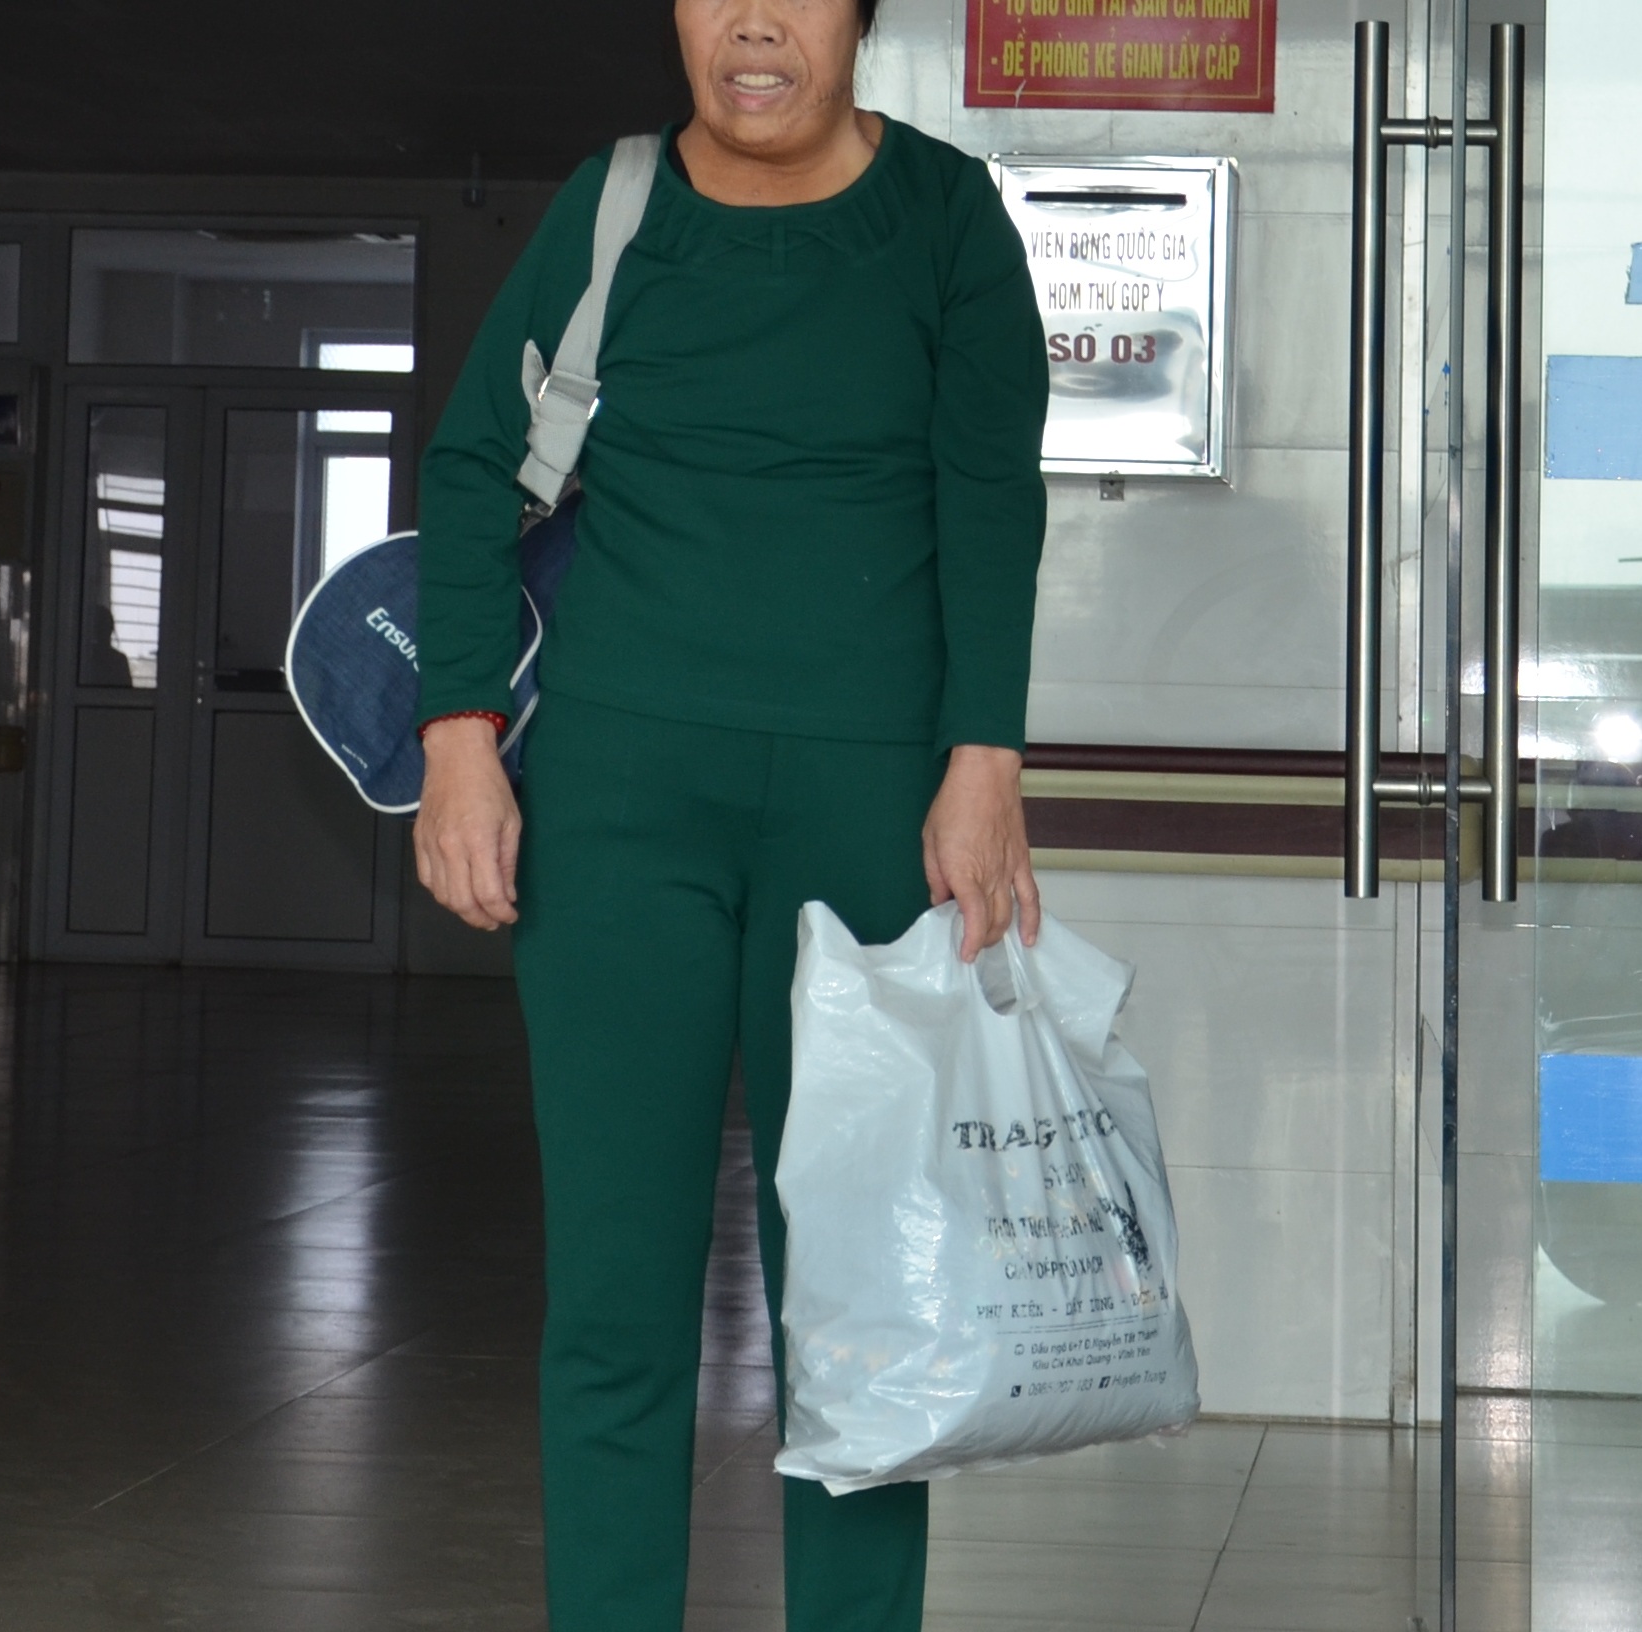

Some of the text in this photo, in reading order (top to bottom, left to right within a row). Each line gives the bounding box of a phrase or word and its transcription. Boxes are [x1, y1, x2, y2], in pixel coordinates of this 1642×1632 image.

[1002, 26, 1240, 81] ĐỀ PHÒNG KẺ GIAN LẤY CẮP
[1162, 234, 1186, 261] GIA
[1089, 280, 1116, 310] THƯ
[1111, 334, 1156, 364] 03
